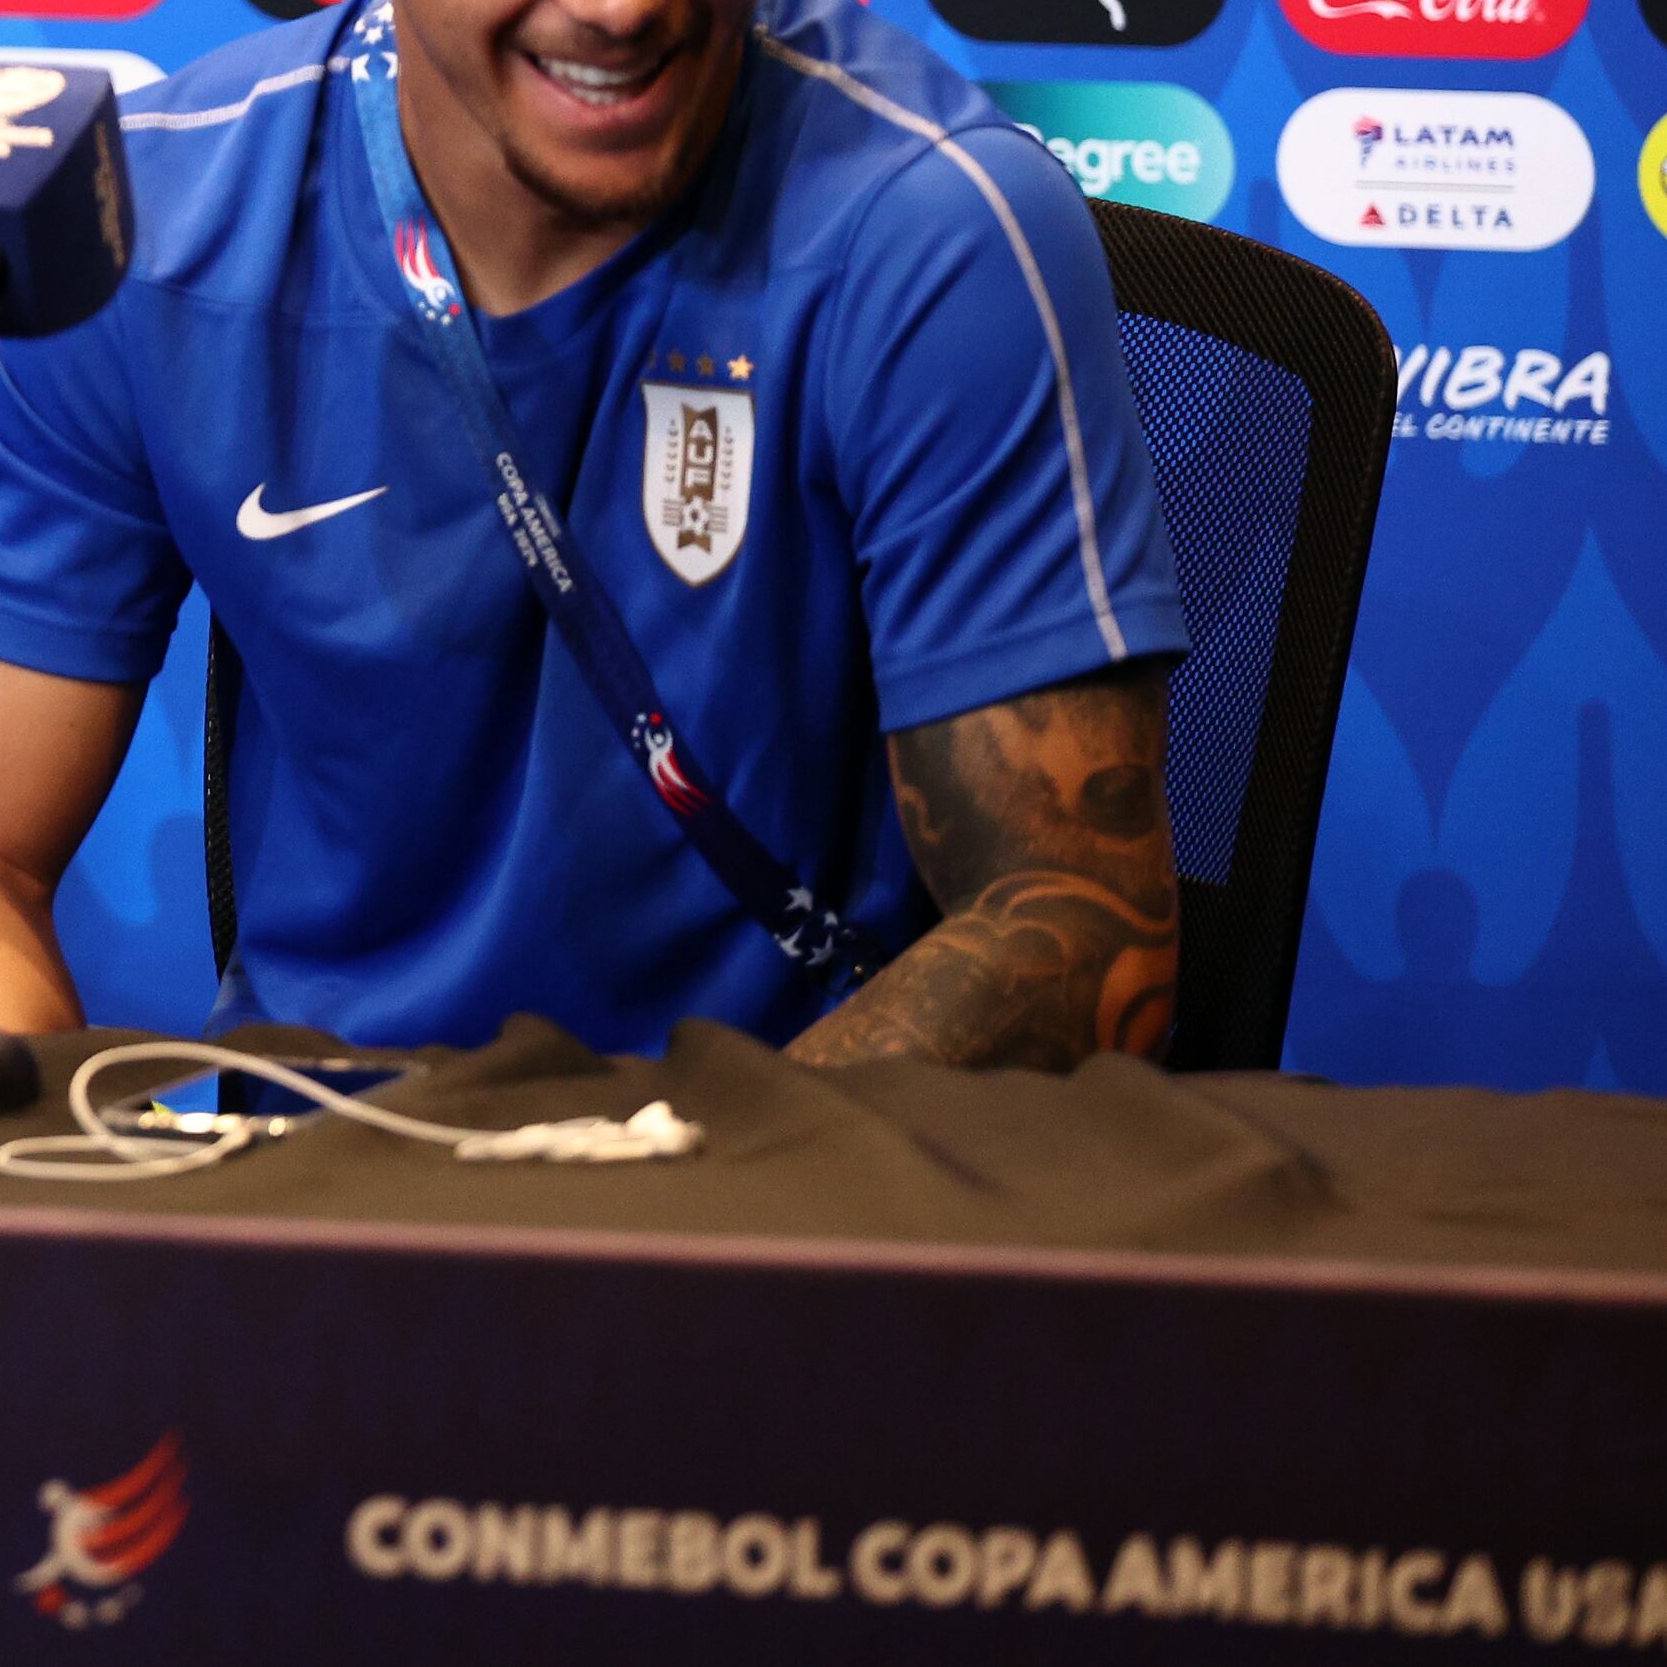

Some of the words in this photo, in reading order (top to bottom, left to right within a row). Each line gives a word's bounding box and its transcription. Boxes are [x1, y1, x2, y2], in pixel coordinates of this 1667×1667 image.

[1014, 123, 1201, 195] egree
[1396, 125, 1515, 145] LATAM
[1397, 157, 1515, 171] AIRLINES
[1399, 205, 1513, 227] DELTA
[1392, 343, 1611, 416] VIBRA
[685, 419, 714, 489] AUF
[1425, 412, 1611, 446] CONTINENTE
[495, 451, 529, 507] COPA
[520, 507, 575, 594] AMERICA
[347, 1496, 839, 1598] CONMEBOL
[852, 1522, 1093, 1609] COPA
[1104, 1538, 1504, 1631] AMERICA
